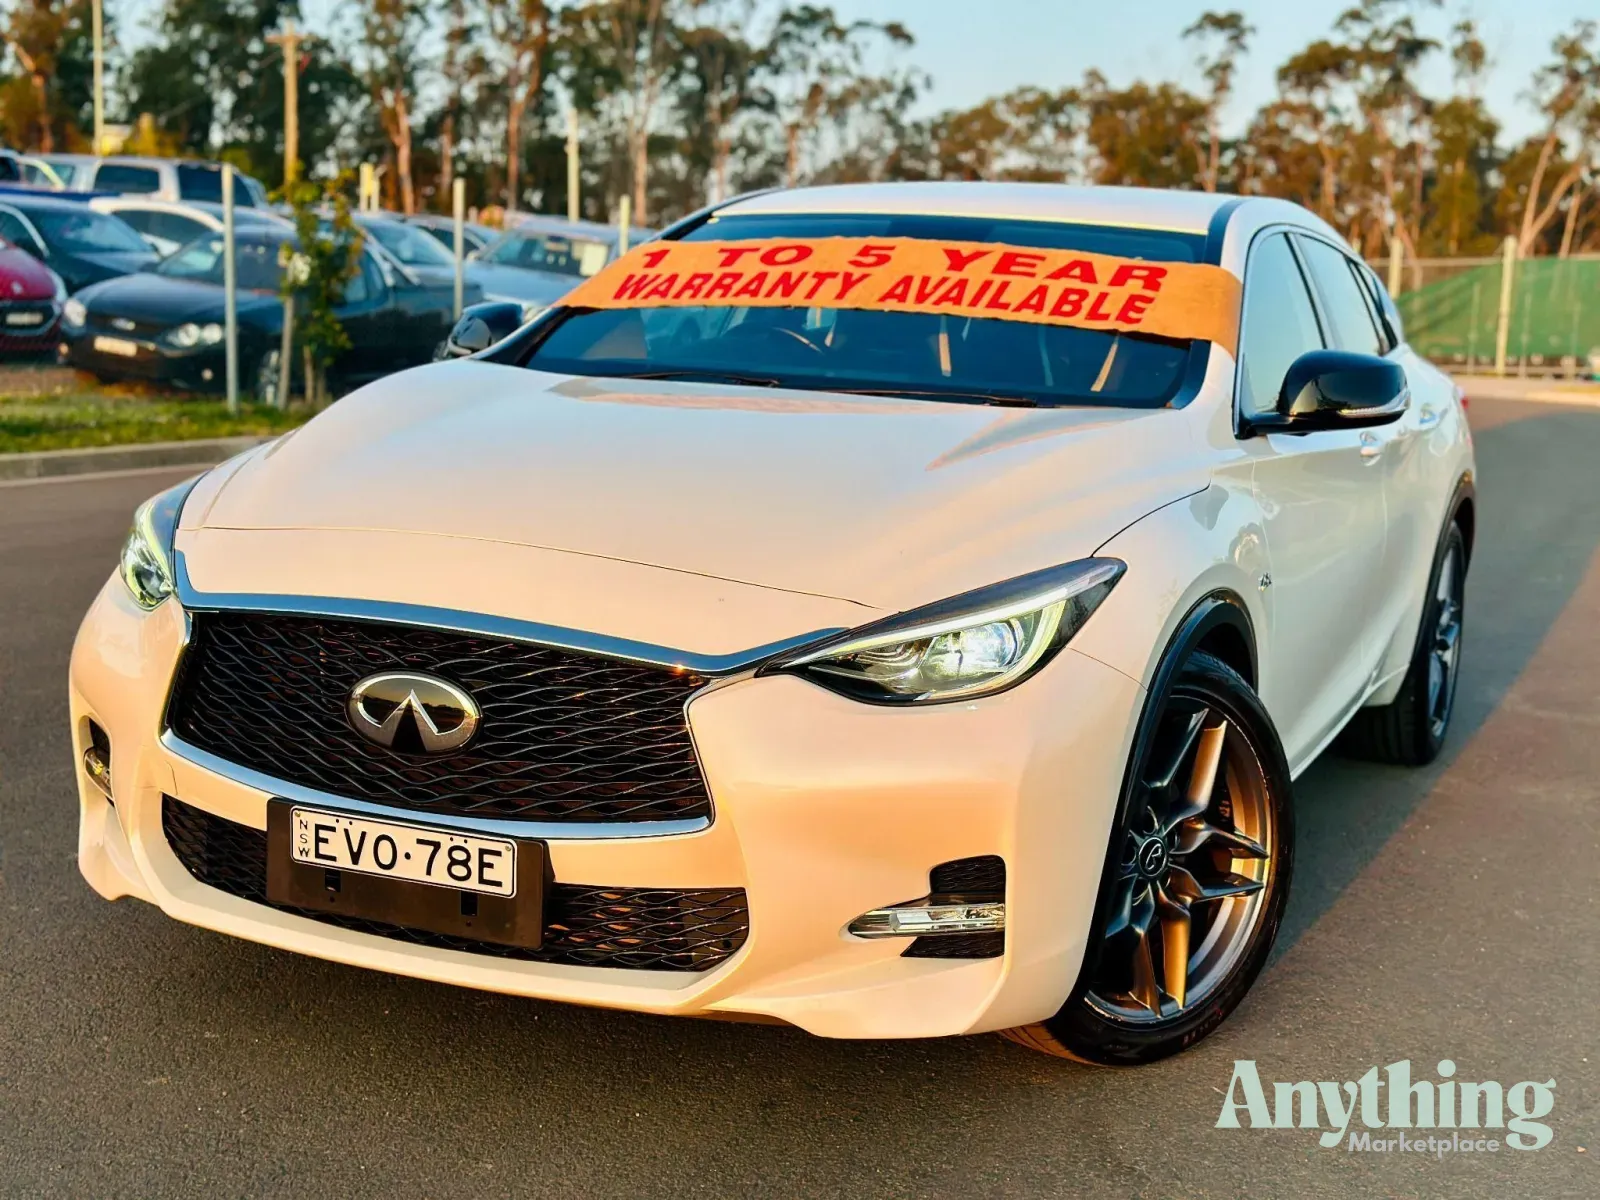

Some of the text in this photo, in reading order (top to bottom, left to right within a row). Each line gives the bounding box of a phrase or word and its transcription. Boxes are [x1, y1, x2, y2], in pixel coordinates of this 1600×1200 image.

[643, 244, 1168, 292] 1 TO 5 YEAR
[612, 271, 1156, 325] WARRANTY AVAILABLE
[298, 818, 311, 858] NSW
